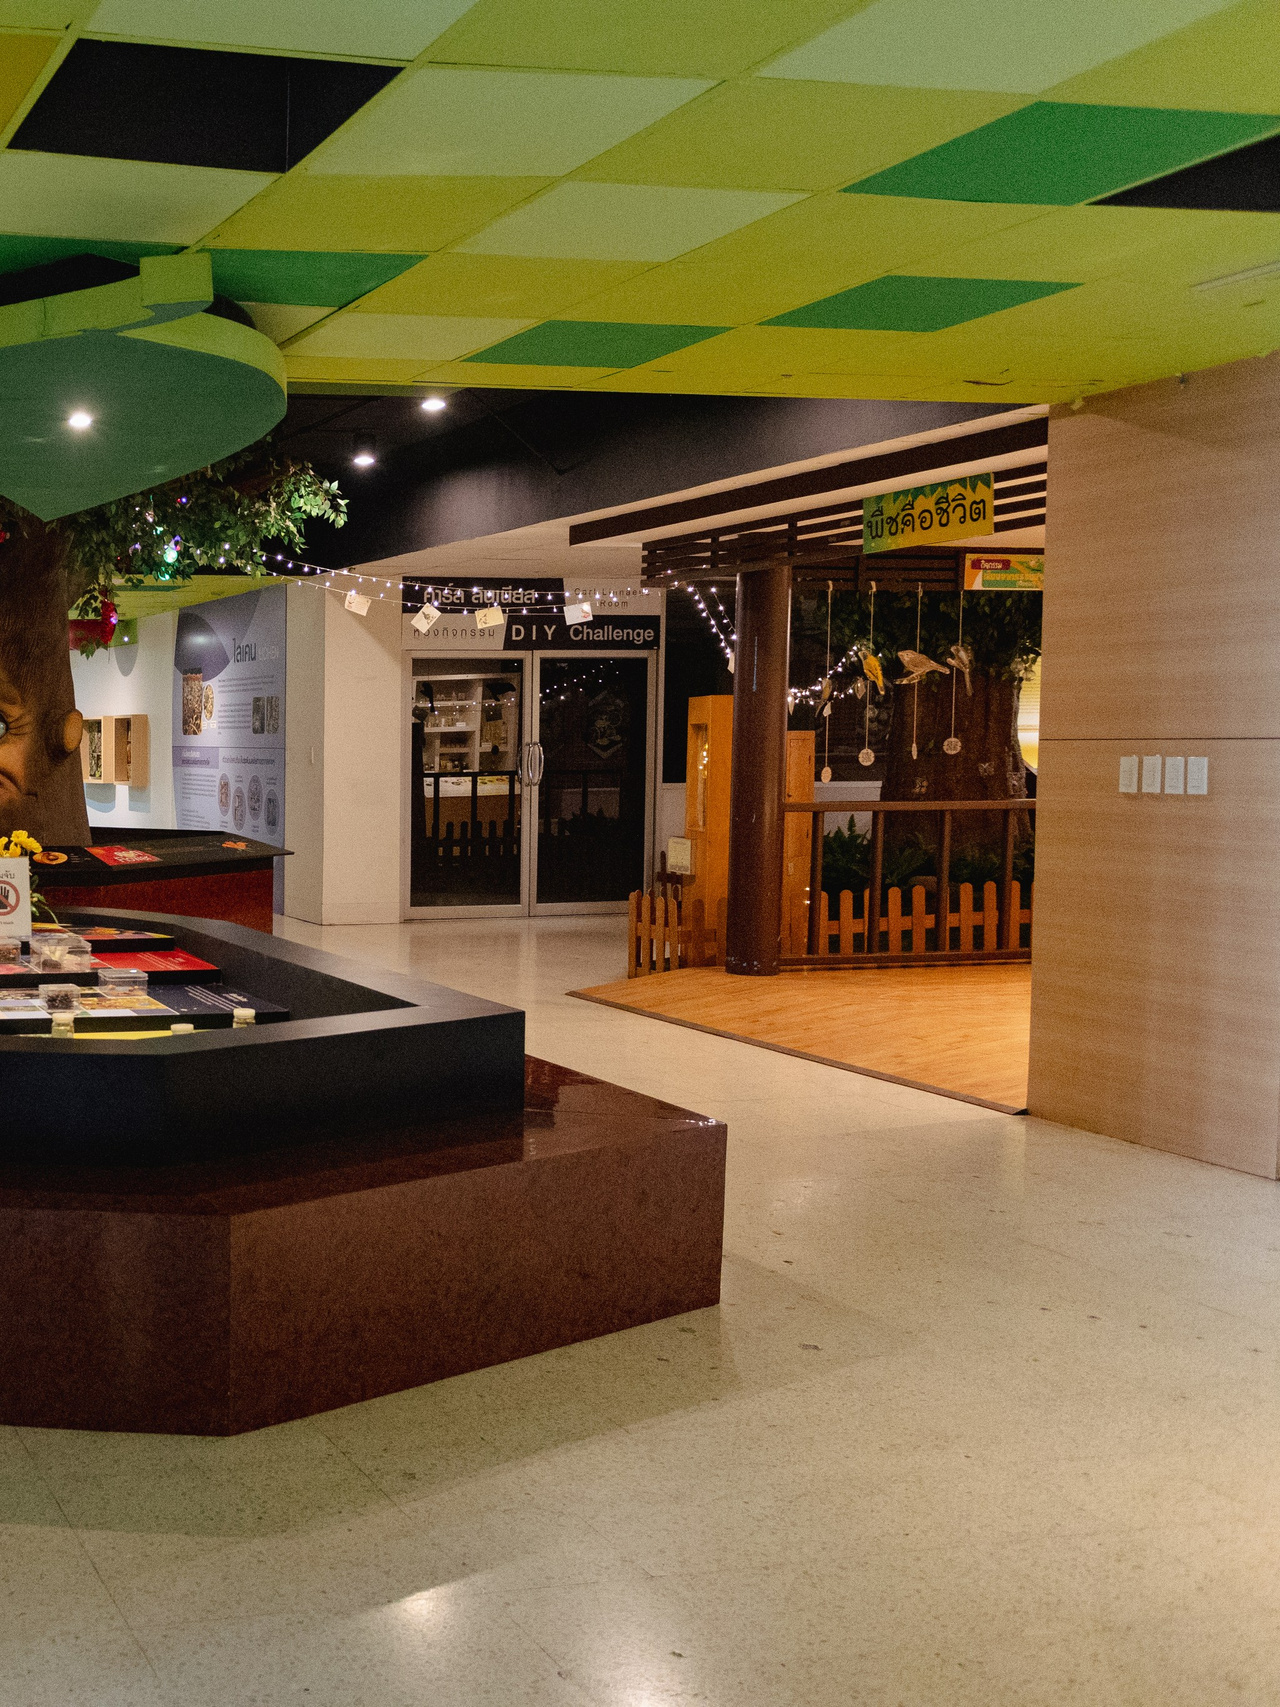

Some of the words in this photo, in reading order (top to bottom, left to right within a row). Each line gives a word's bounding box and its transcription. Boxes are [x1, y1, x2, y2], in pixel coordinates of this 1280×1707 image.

[866, 492, 987, 540] พืชคือชีวิต
[570, 624, 655, 645] Challenge
[232, 637, 257, 664] ไลเคน
